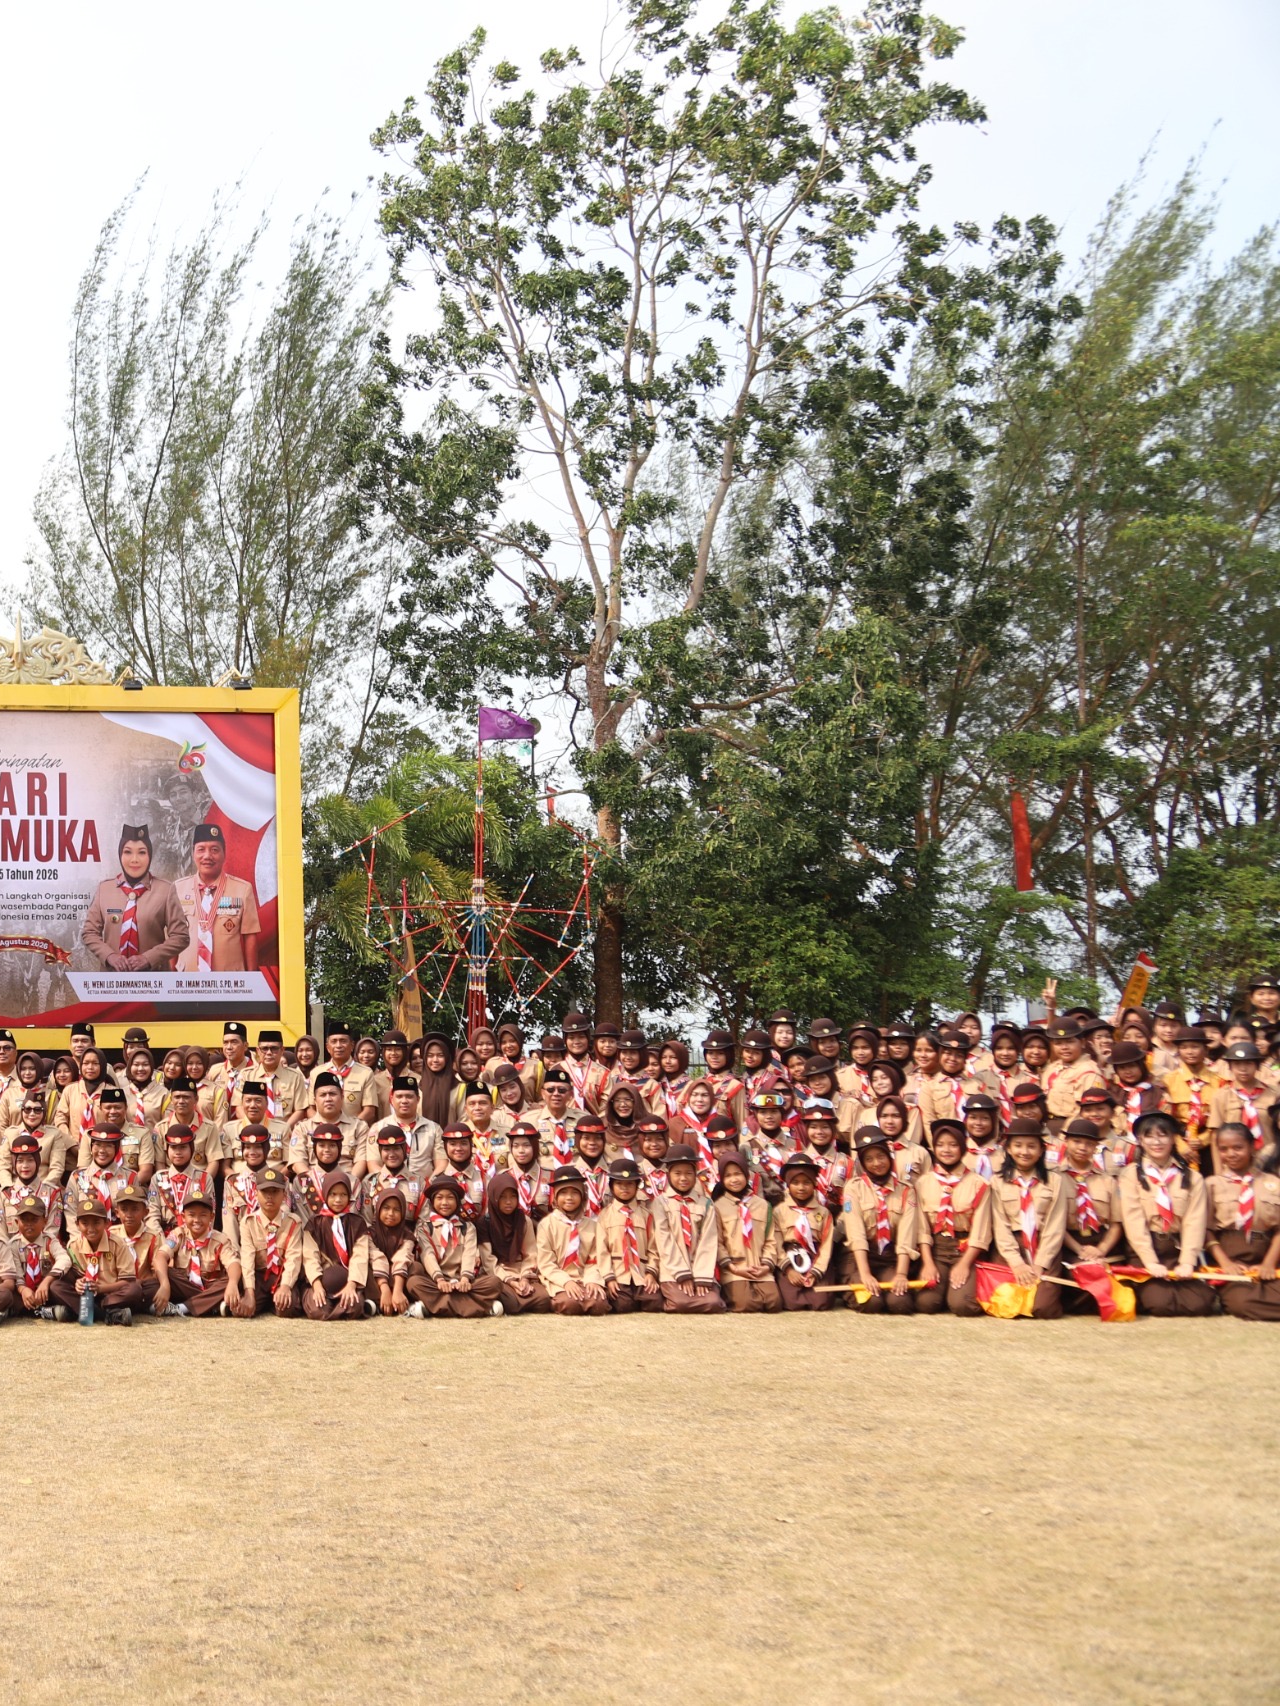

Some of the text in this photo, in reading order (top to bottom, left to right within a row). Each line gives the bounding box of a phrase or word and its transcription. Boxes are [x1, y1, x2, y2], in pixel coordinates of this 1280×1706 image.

[6, 868, 34, 880] Tahun
[36, 868, 59, 881] 2026
[5, 892, 43, 901] Langkah
[44, 892, 91, 901] Organisasi
[55, 903, 89, 912] Pangan
[31, 913, 55, 921] Emas
[56, 913, 78, 921] 2045
[0, 939, 30, 947] Agustus
[30, 939, 49, 949] 2026
[91, 980, 105, 988] WENI
[106, 980, 115, 988] LIS
[115, 980, 152, 989] DARMANSYAH,
[185, 980, 200, 988] IMAM
